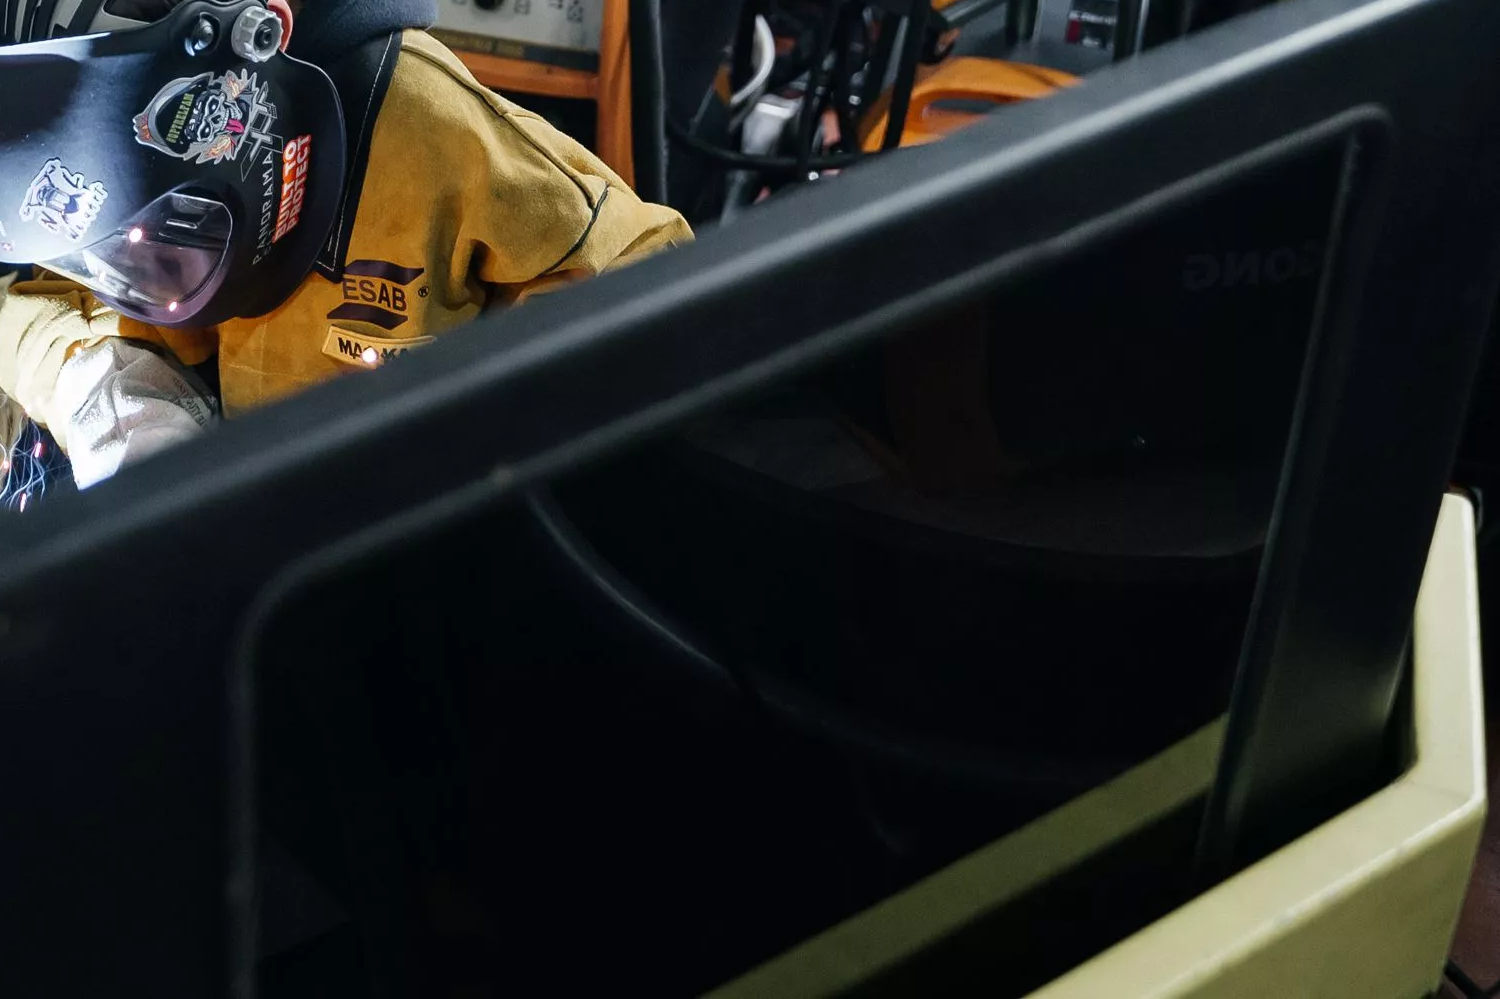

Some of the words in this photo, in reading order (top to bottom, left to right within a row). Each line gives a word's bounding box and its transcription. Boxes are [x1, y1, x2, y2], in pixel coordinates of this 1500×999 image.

[284, 140, 298, 176] TO
[286, 135, 311, 231] PROTECT
[275, 181, 296, 241] BUILT
[342, 277, 407, 312] ESAB
